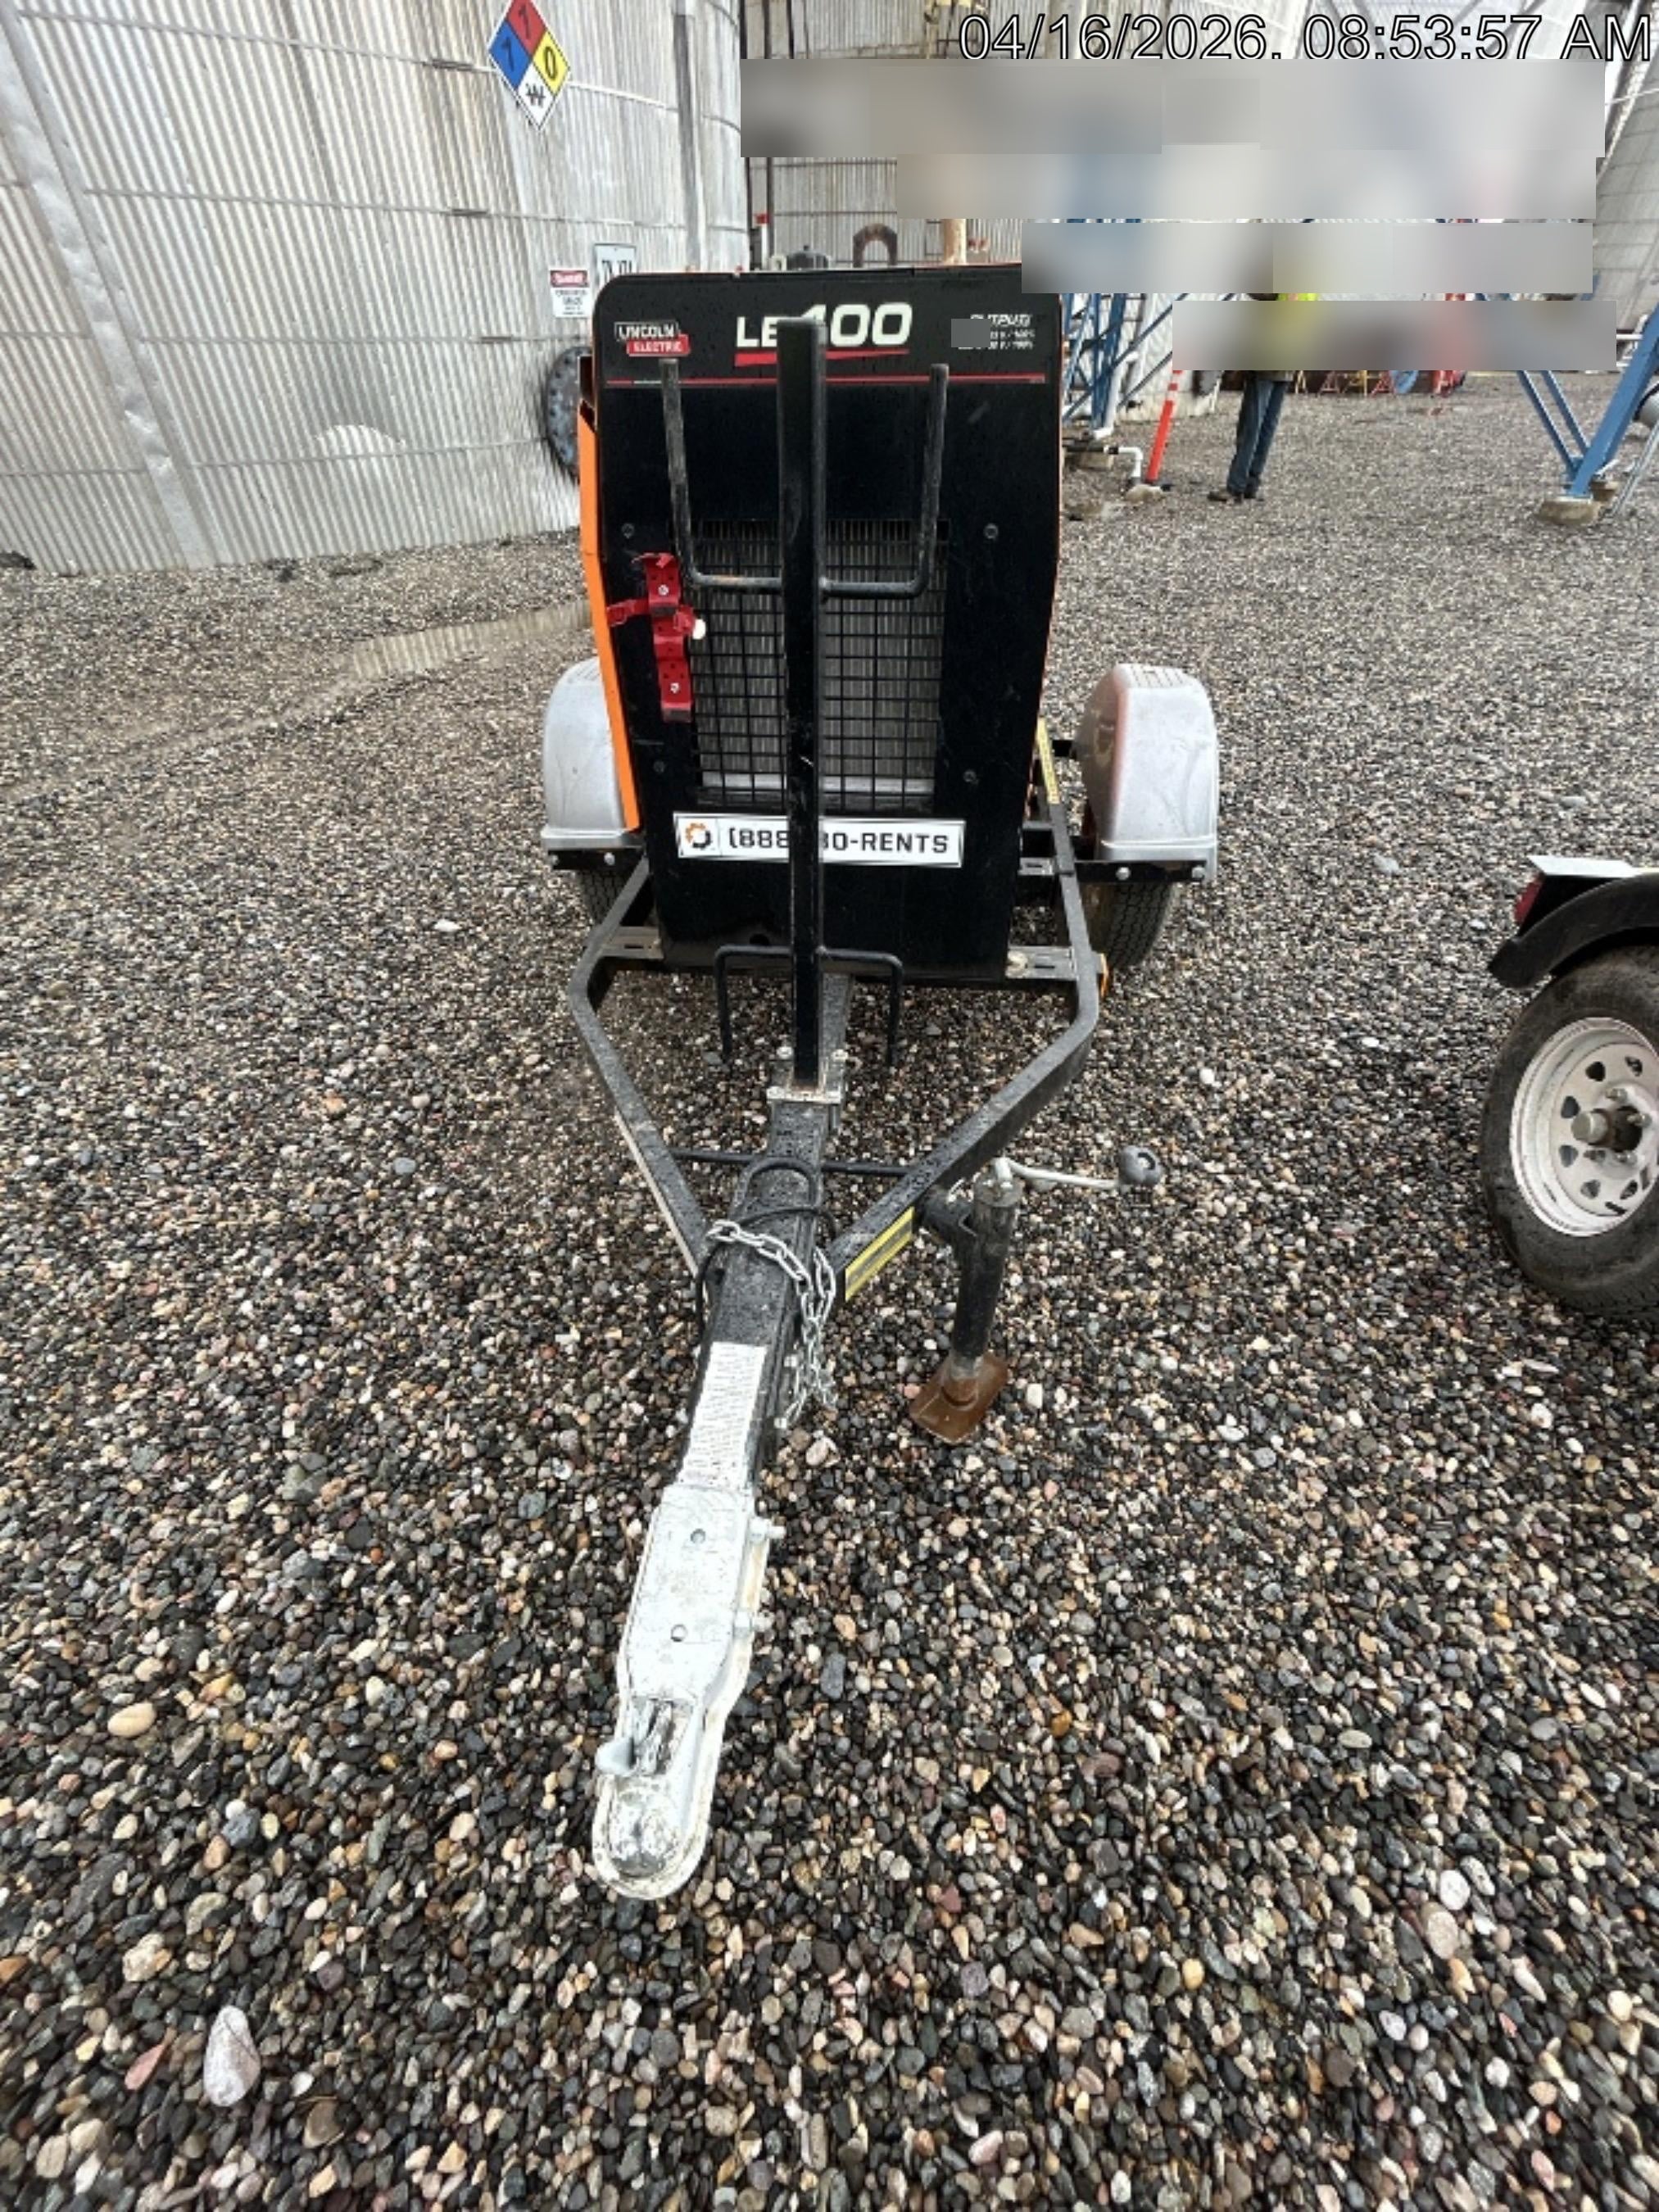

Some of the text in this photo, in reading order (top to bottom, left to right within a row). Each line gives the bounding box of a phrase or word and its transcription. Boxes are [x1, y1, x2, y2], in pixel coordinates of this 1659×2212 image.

[543, 45, 558, 80] 0
[618, 324, 675, 340] LINCOLN
[736, 302, 913, 347] LE00
[633, 341, 683, 353] ELECTRIC
[728, 827, 790, 849] (888
